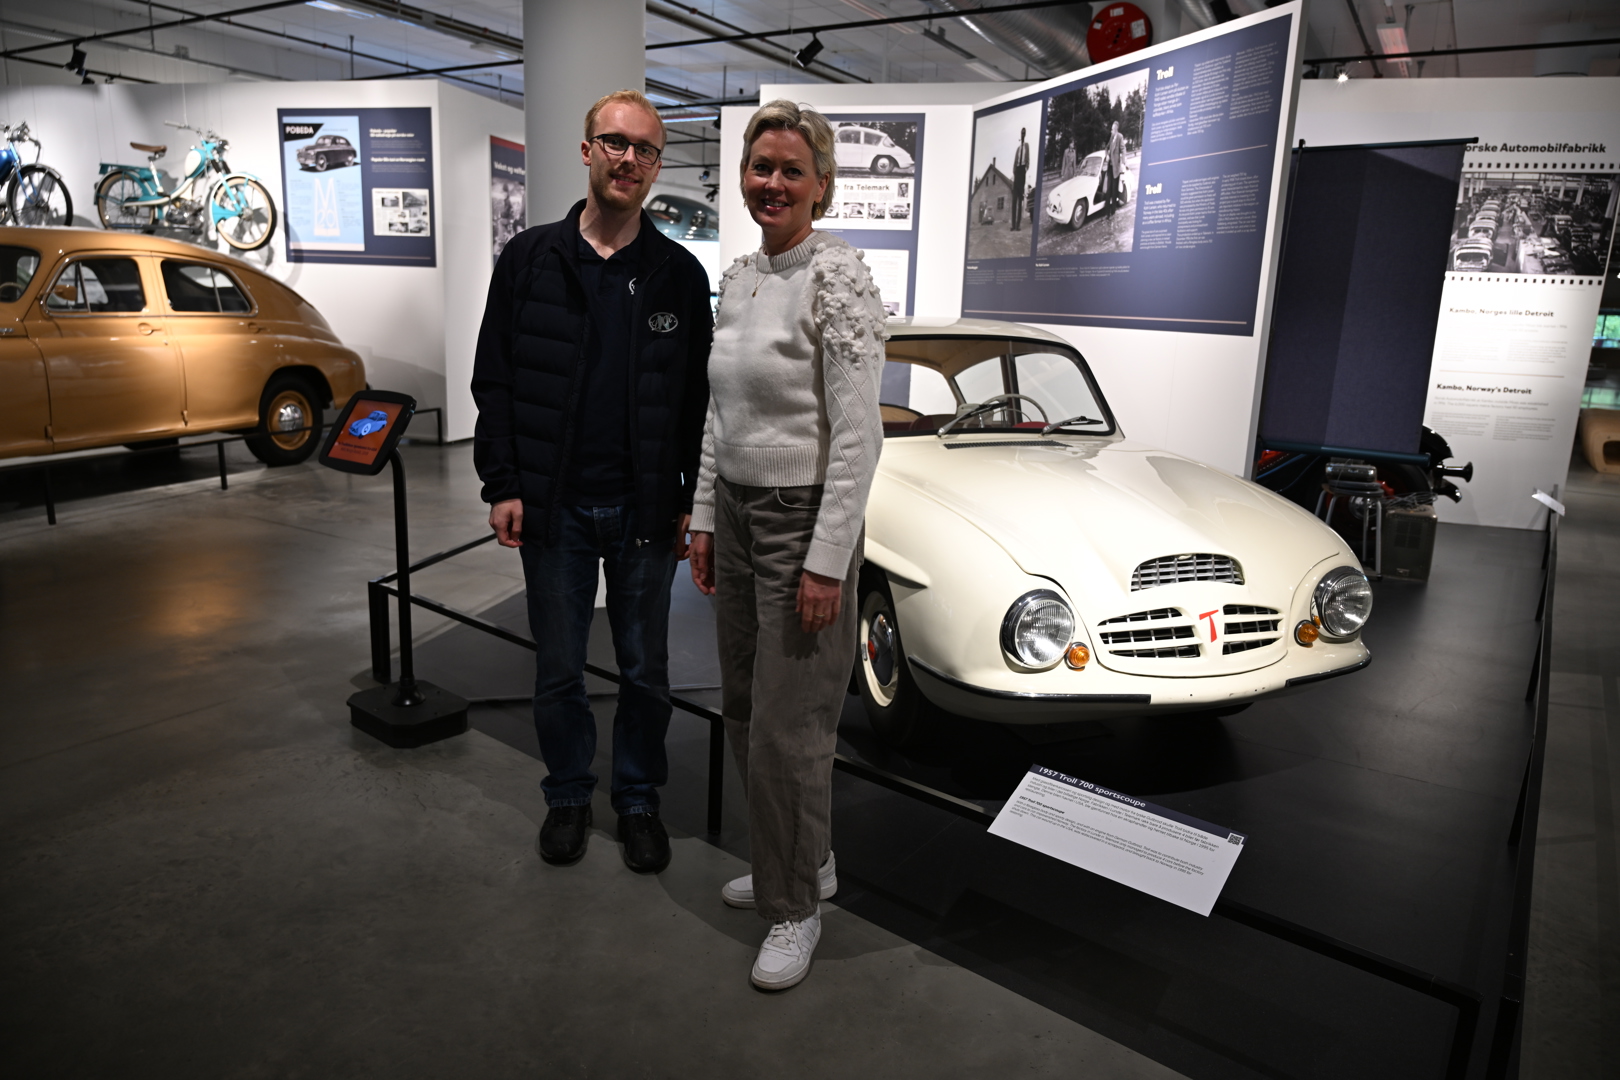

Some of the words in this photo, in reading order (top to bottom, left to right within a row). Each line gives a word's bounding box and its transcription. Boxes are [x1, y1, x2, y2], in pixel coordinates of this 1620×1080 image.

[1157, 66, 1174, 80] Troll
[286, 126, 314, 134] POBEDA
[1464, 143, 1498, 152] orske
[1500, 143, 1606, 153] Automobilfabrikk
[1146, 182, 1162, 195] Troll
[1466, 385, 1501, 394] Norway's
[1199, 609, 1218, 642] T
[1039, 767, 1058, 776] 1957
[1060, 773, 1077, 784] Troll
[1079, 780, 1093, 789] 700
[1095, 786, 1146, 808] sportscoupe
